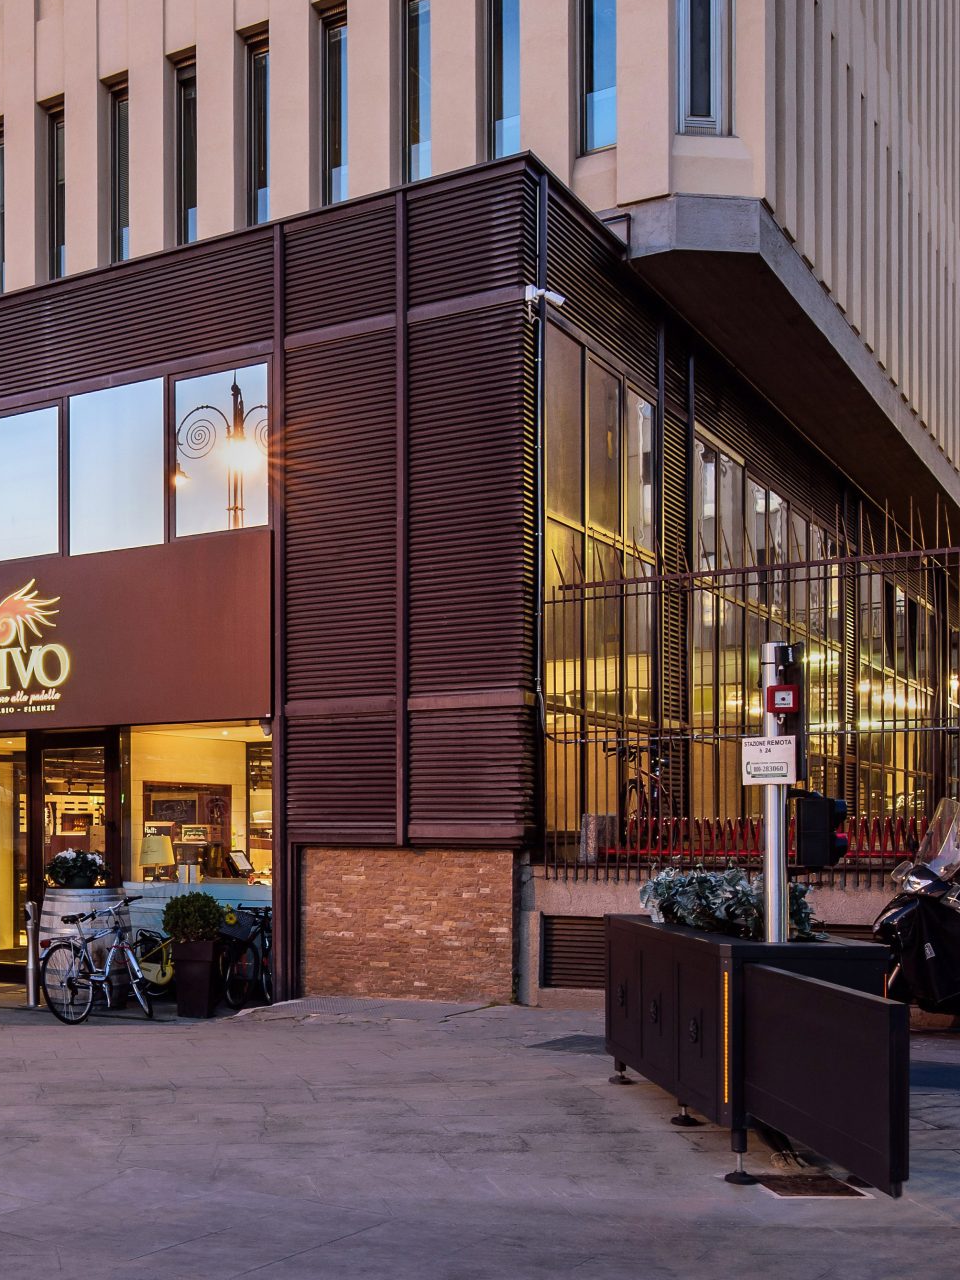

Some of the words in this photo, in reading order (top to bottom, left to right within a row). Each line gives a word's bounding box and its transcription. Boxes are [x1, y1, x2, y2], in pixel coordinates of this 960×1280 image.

[10, 691, 29, 702] alla
[29, 689, 61, 705] padella
[24, 705, 56, 713] FIRENZE
